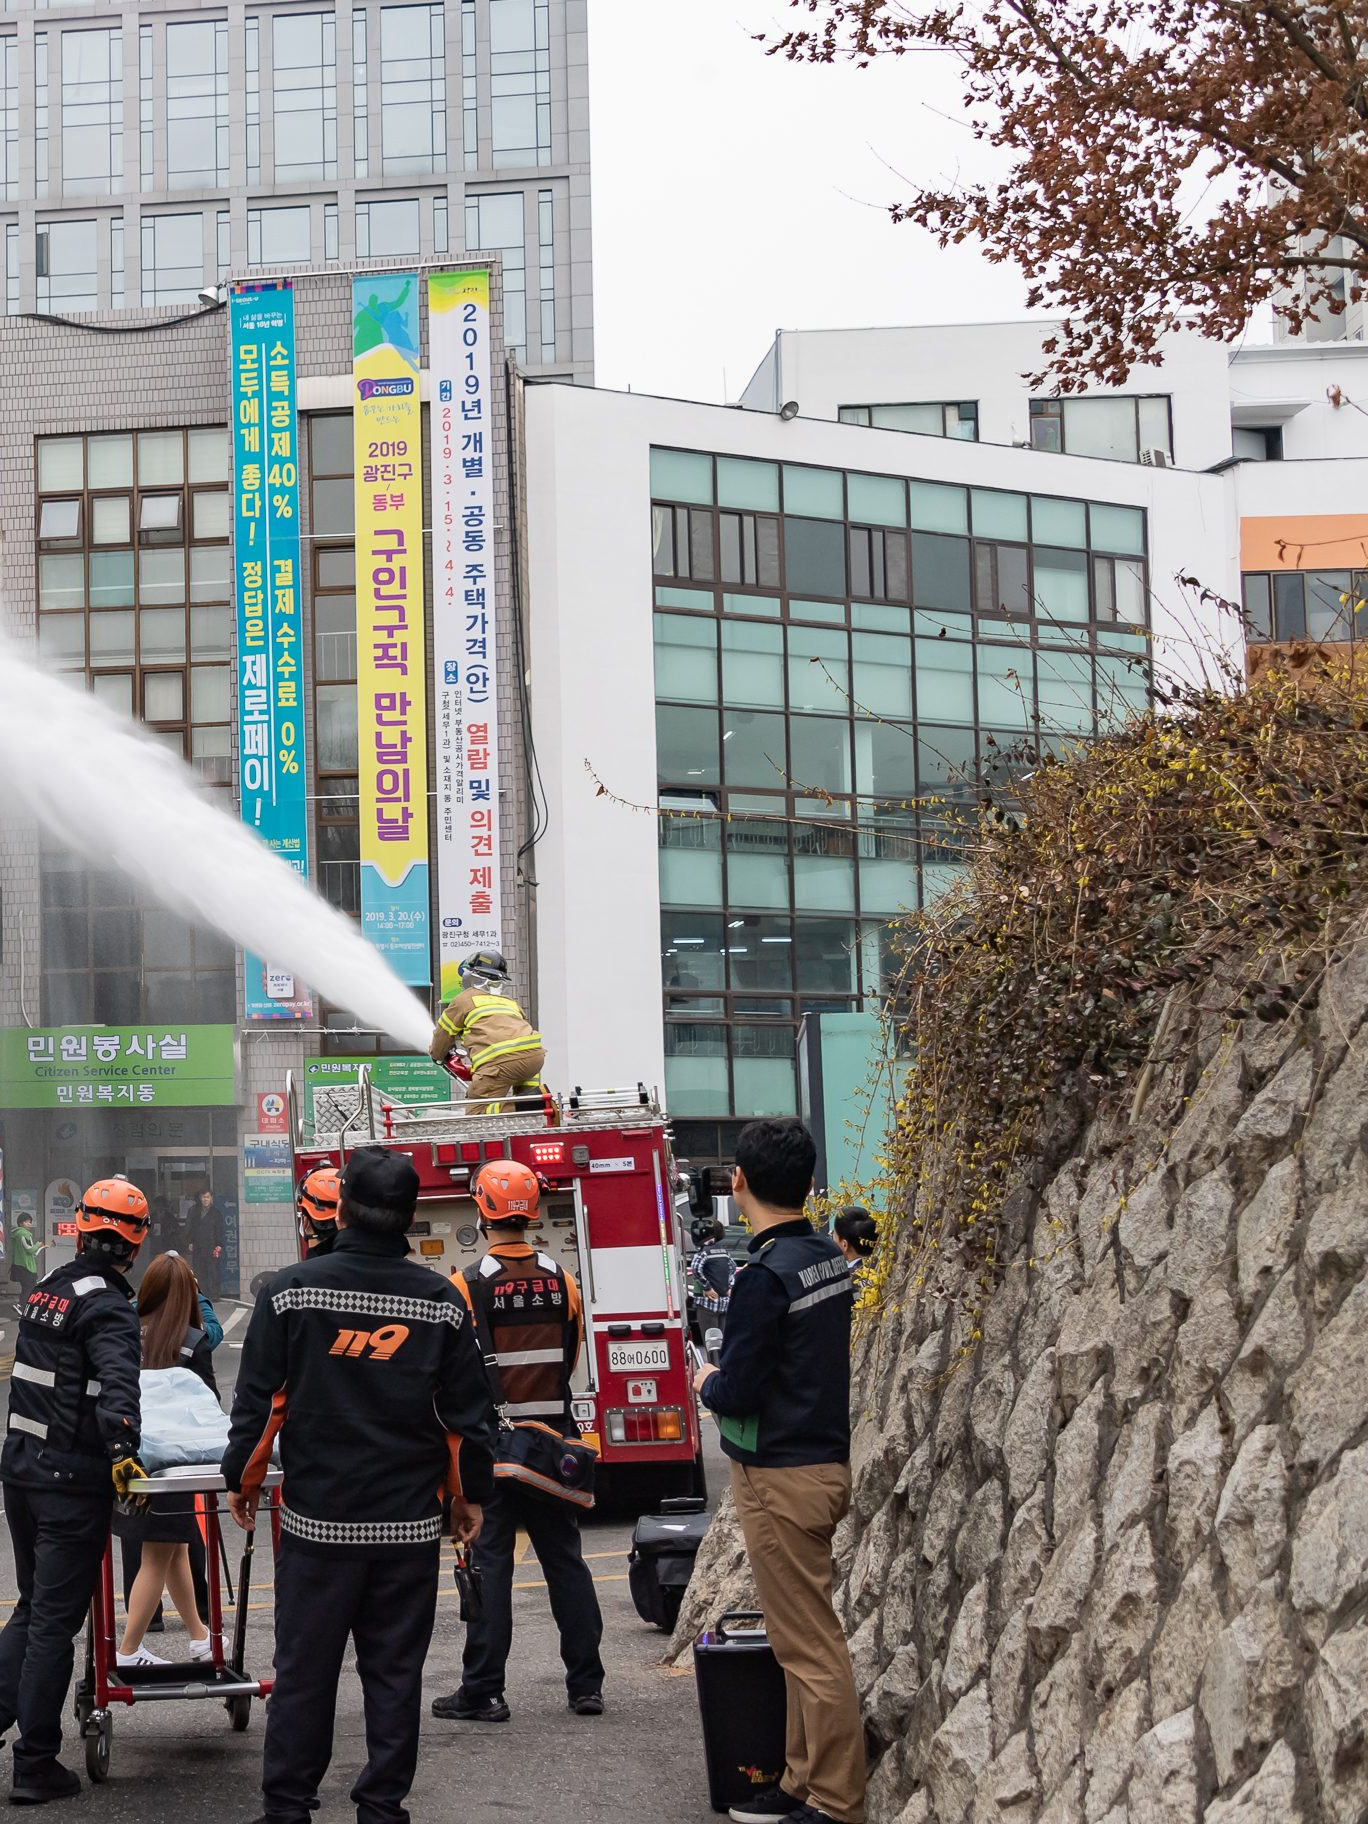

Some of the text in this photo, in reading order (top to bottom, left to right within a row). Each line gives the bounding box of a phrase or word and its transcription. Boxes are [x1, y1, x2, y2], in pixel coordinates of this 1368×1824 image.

[462, 303, 482, 421] 2019년
[238, 344, 260, 453] 모두에게
[440, 380, 452, 401] 기간
[368, 441, 408, 458] 2019
[363, 463, 414, 483] 광진구
[241, 463, 262, 546] 좋다!
[372, 493, 406, 512] 동부
[273, 559, 295, 615] 결제
[242, 561, 265, 647] 정답은
[371, 529, 409, 676] 구인구직
[275, 622, 298, 708] 수수료
[445, 661, 457, 683] 장소
[454, 690, 463, 716] 인터넷
[278, 721, 299, 774] 0%
[466, 722, 490, 770] 열람
[468, 778, 491, 802] 및
[469, 808, 493, 857] 의견
[469, 866, 493, 914] 제출
[365, 911, 386, 921] 2019.
[389, 911, 396, 921] 3.
[444, 918, 460, 927] 문의
[441, 930, 498, 939] 광진구청 세무1과
[27, 1034, 188, 1062] 민원봉사실
[35, 1063, 177, 1077] Citizen Service Center
[56, 1083, 156, 1104] 민원복지동
[328, 1324, 410, 1360] 119
[611, 1350, 667, 1365] 88어0600
